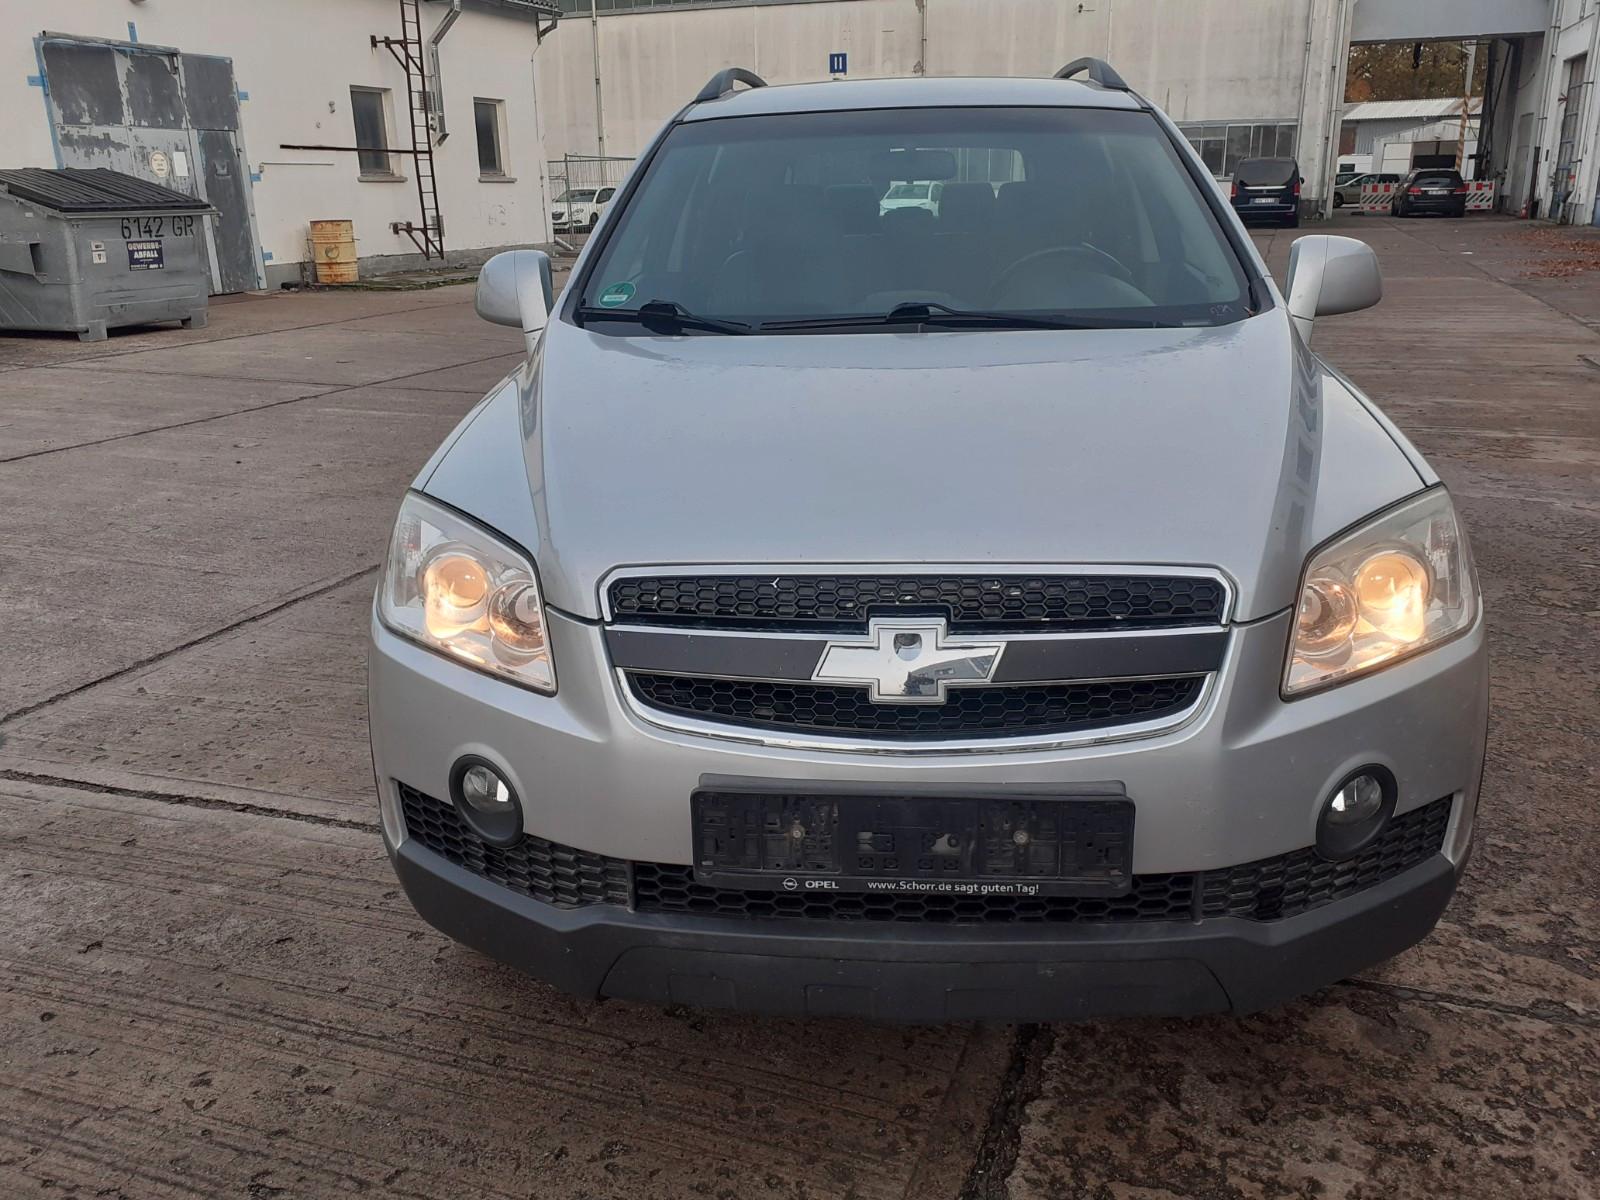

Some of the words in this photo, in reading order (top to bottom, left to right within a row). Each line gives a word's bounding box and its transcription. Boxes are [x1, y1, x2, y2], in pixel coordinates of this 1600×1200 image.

[121, 216, 165, 239] 6142
[172, 215, 195, 237] GR
[133, 250, 159, 259] ABFALL
[804, 880, 840, 889] OPEL
[867, 880, 952, 890] www.Schorr.de
[954, 883, 979, 894] sagt
[980, 884, 1014, 895] guten
[1015, 883, 1040, 896] Tag!
